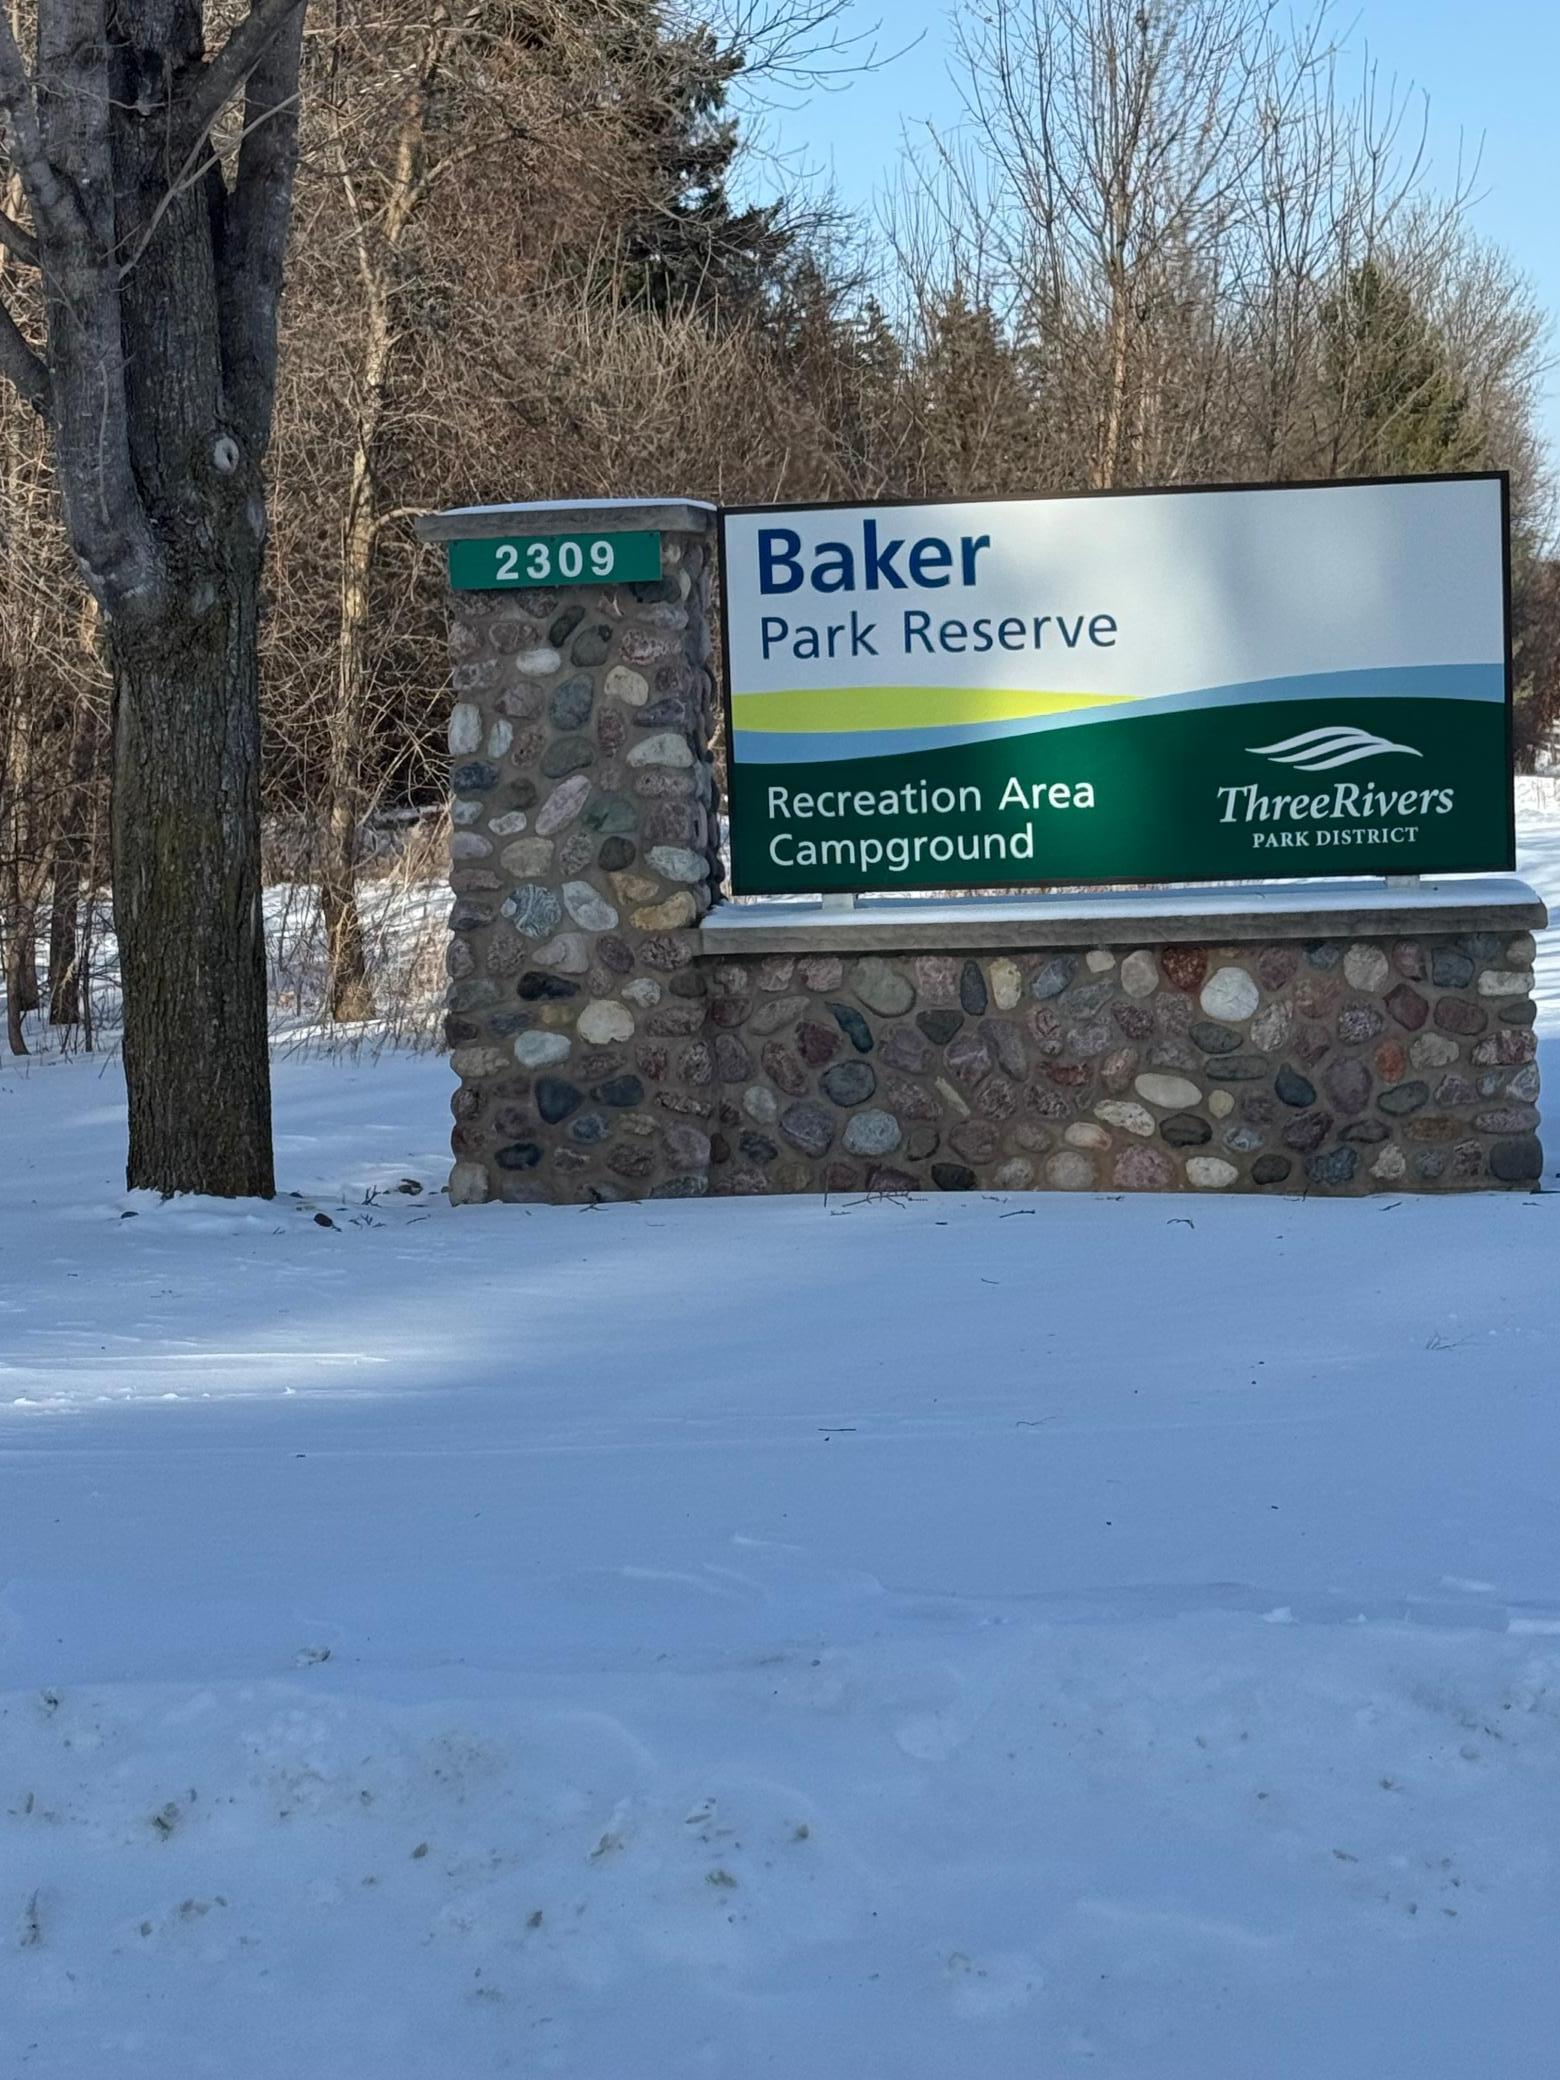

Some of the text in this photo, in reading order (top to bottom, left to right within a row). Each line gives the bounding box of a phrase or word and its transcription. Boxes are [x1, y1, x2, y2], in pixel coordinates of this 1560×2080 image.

[495, 540, 615, 580] 2309
[758, 519, 990, 595] Baker
[761, 611, 1118, 659] Park Reserve
[768, 777, 1096, 819] Recreation Area
[769, 823, 1035, 872] Campground
[1252, 826, 1419, 849] PARK DISTRICT
